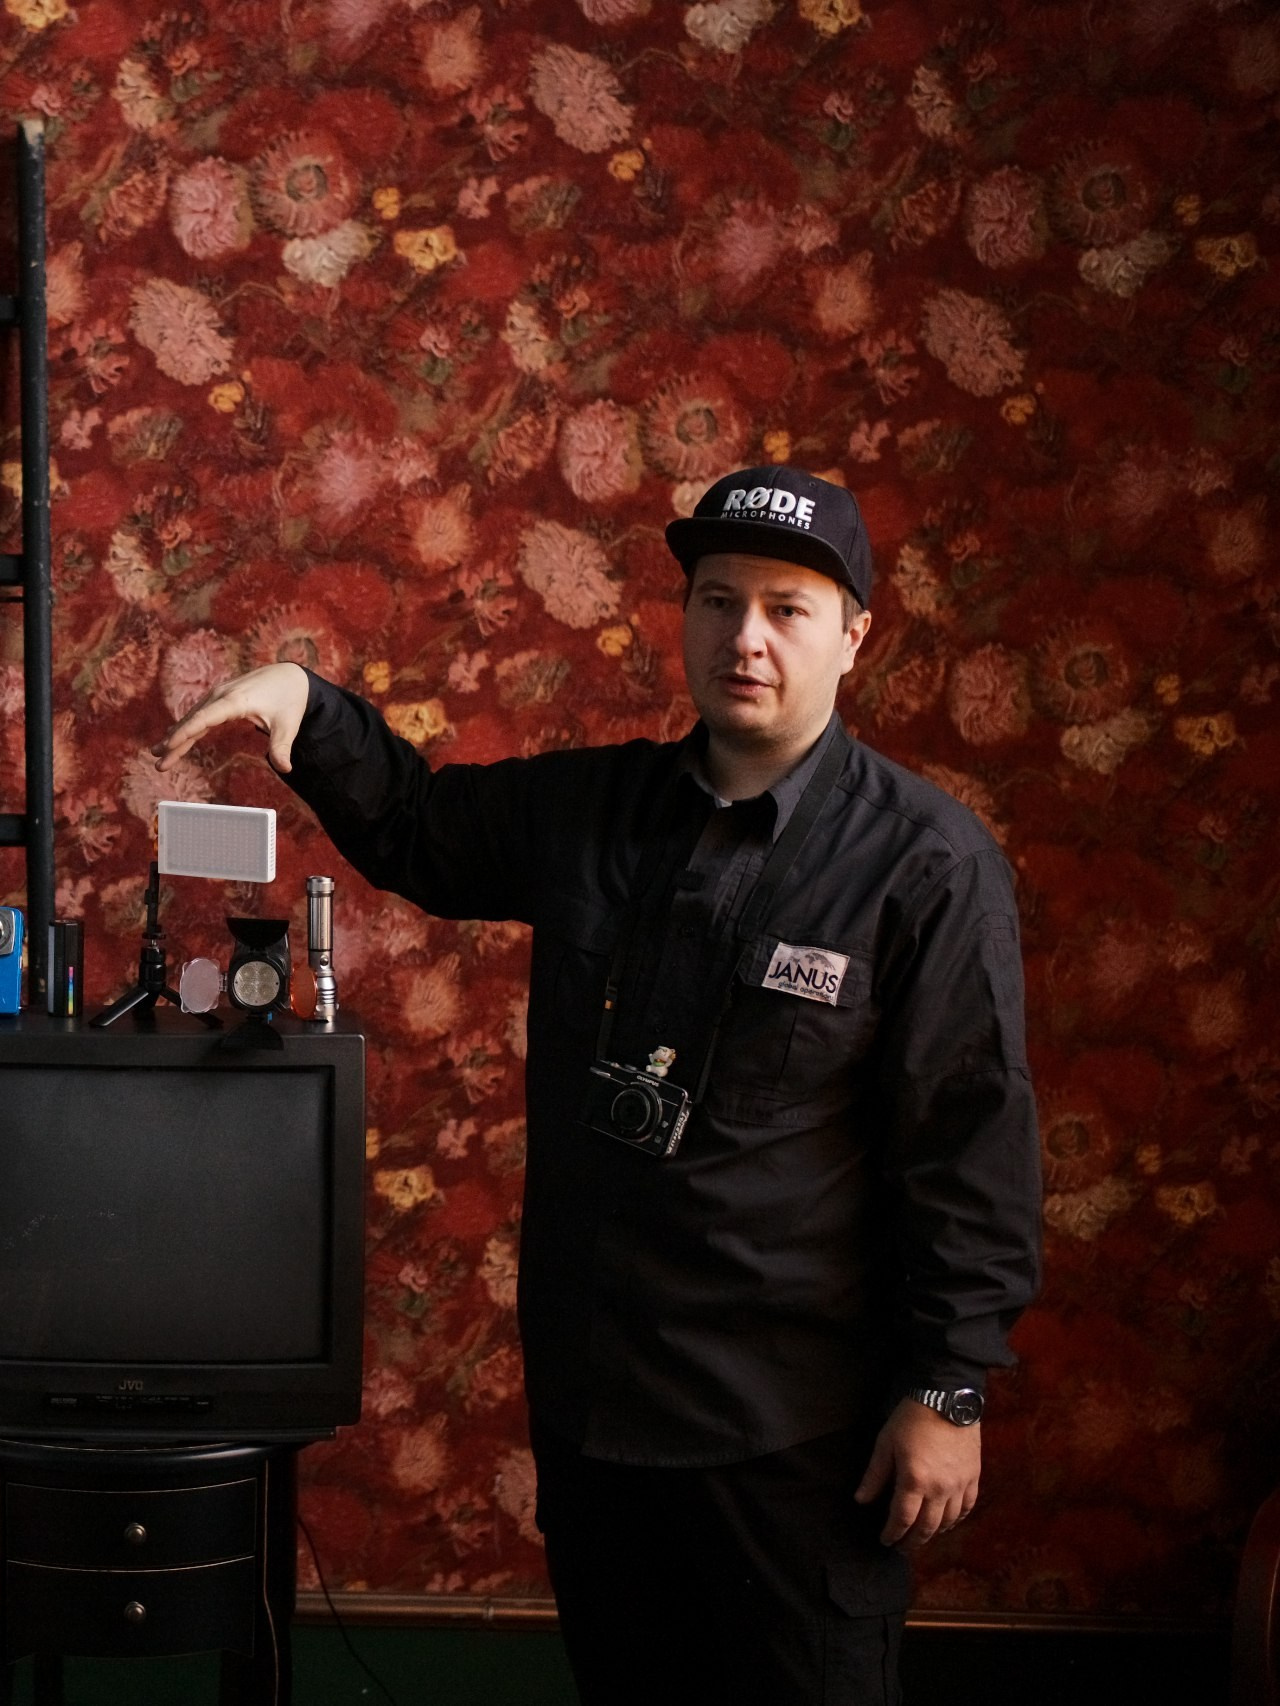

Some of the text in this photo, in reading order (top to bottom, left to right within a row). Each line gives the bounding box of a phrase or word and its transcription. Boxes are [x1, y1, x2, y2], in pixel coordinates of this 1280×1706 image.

[723, 486, 816, 522] RØDE
[720, 510, 811, 530] MICROPHONES
[768, 961, 839, 994] JANUS
[636, 1075, 660, 1088] OLYMPUS
[118, 1379, 144, 1391] JVC
